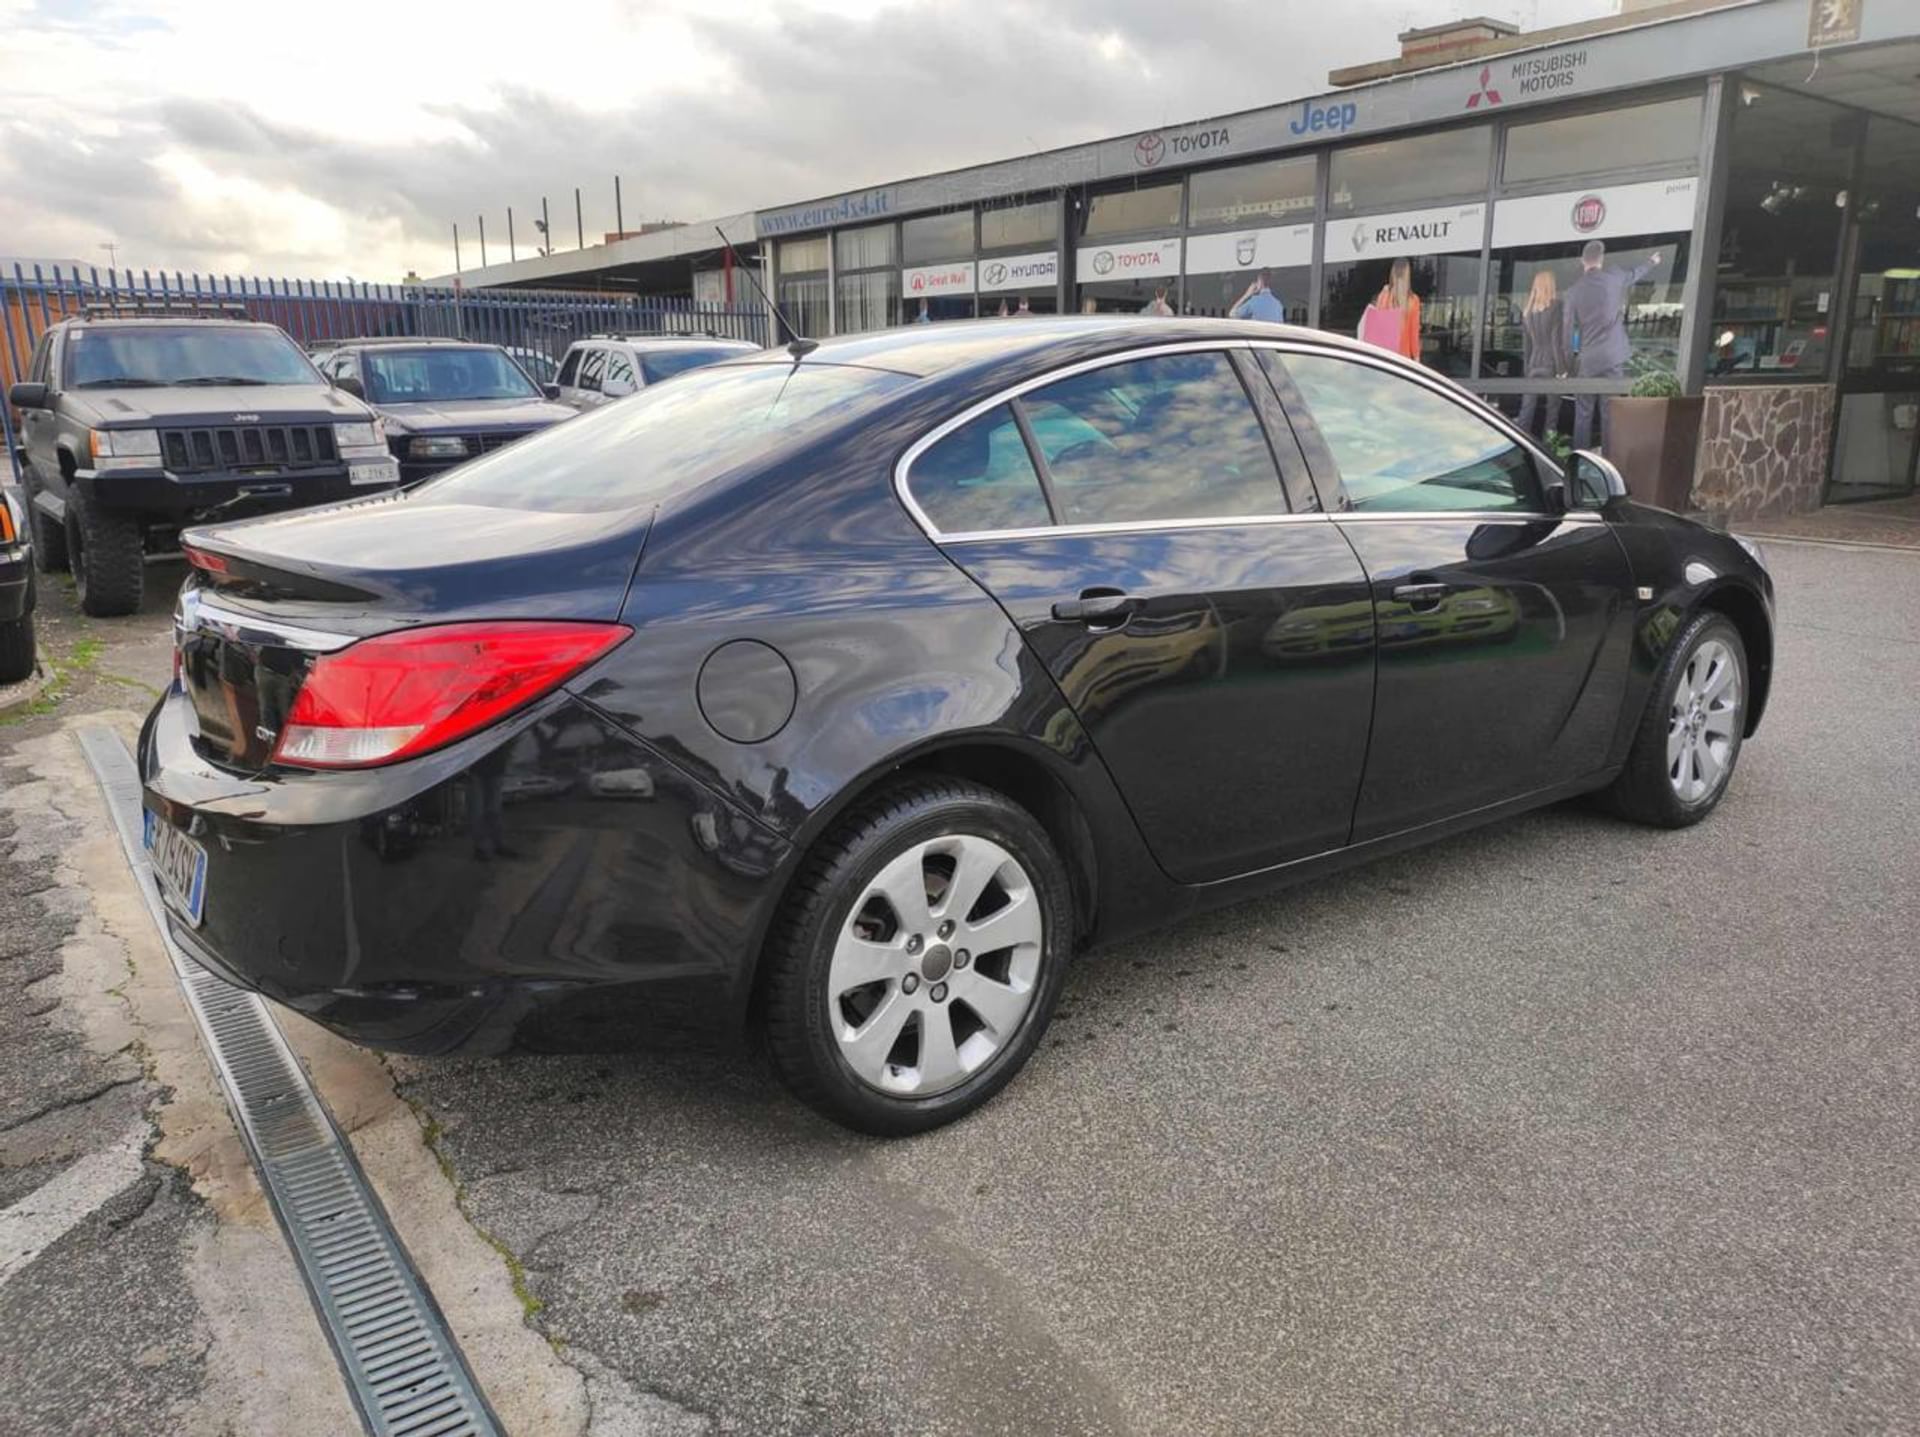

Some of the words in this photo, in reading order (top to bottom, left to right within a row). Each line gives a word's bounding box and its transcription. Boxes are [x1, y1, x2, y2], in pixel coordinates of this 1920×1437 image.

[1511, 51, 1587, 79] MITSUBISHI
[1520, 71, 1574, 94] MOTORS
[1290, 101, 1356, 134] Jeep
[1172, 128, 1230, 154] TOYOTA
[1375, 220, 1452, 243] RENAULT
[1011, 262, 1056, 278] HYUNDAI
[1117, 251, 1161, 268] TOYOTA
